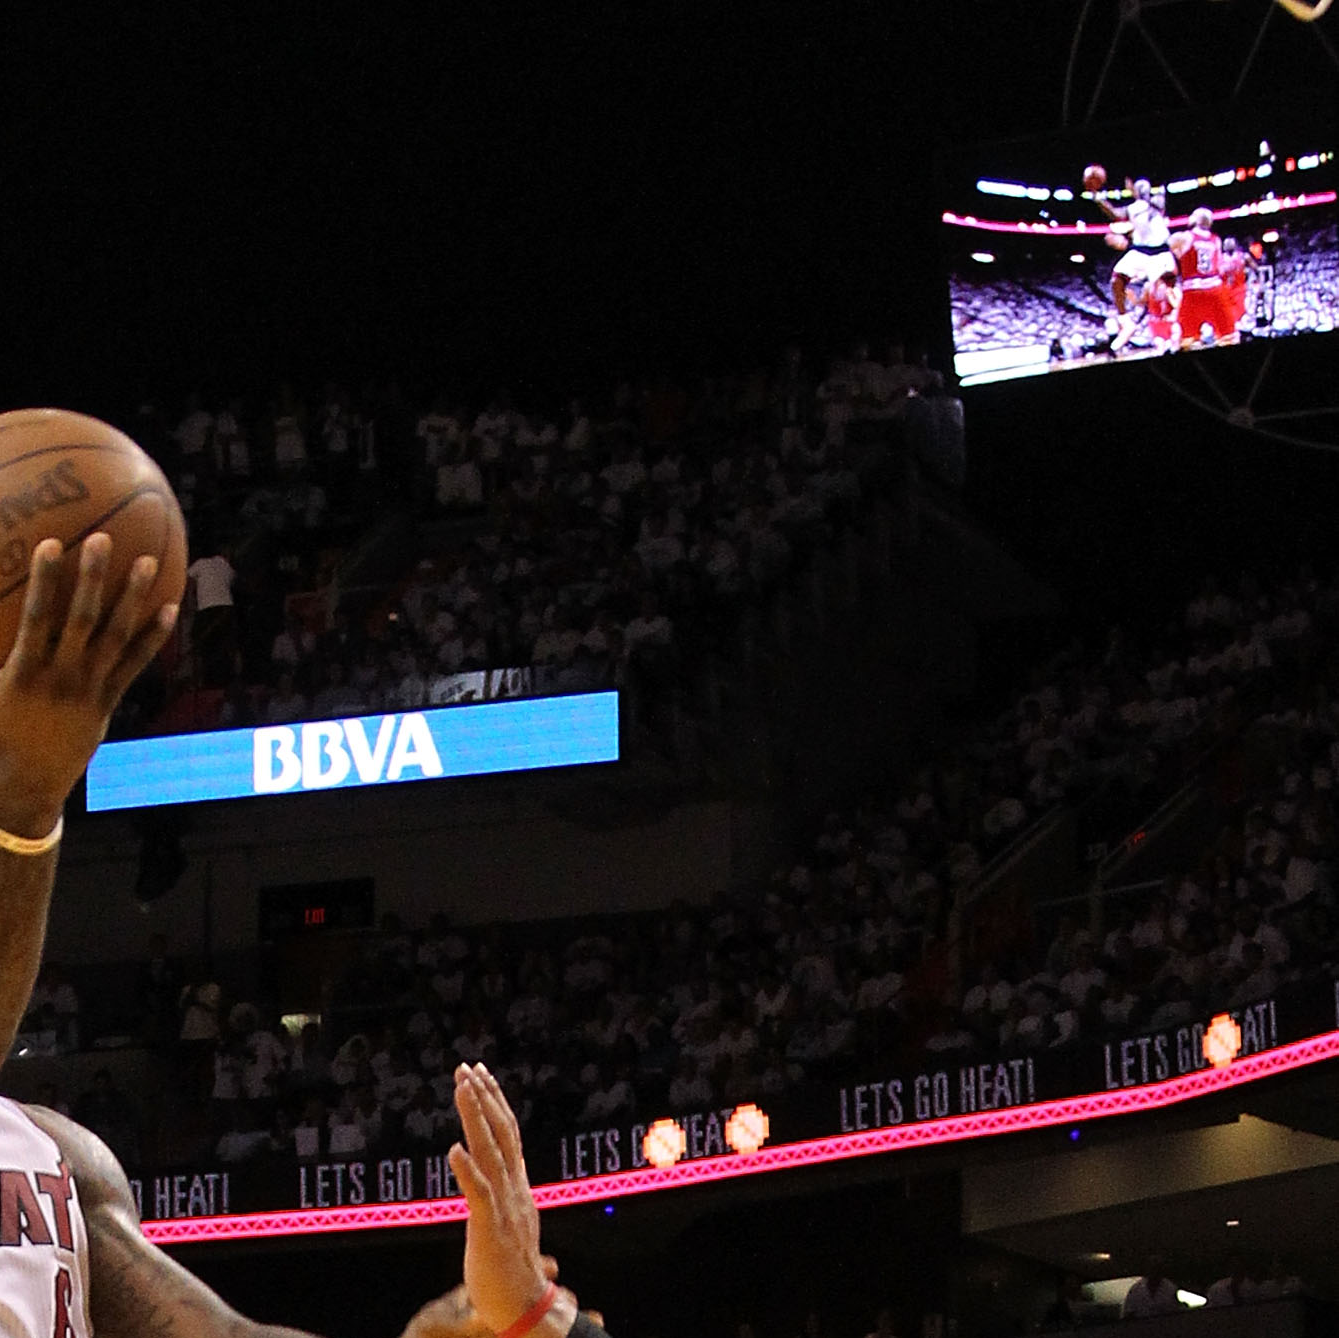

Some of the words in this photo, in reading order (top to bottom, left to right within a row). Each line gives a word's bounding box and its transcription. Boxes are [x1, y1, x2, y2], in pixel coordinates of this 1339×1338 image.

[252, 711, 444, 794] BBVA
[1104, 1034, 1170, 1090] LETS
[839, 1079, 904, 1133] LETS
[914, 1071, 950, 1121] GO
[959, 1056, 1036, 1114] HEAT!
[559, 1127, 622, 1180] LETS
[155, 1172, 230, 1219] HEAT!
[298, 1162, 365, 1209] LETS
[378, 1157, 413, 1203] GO
